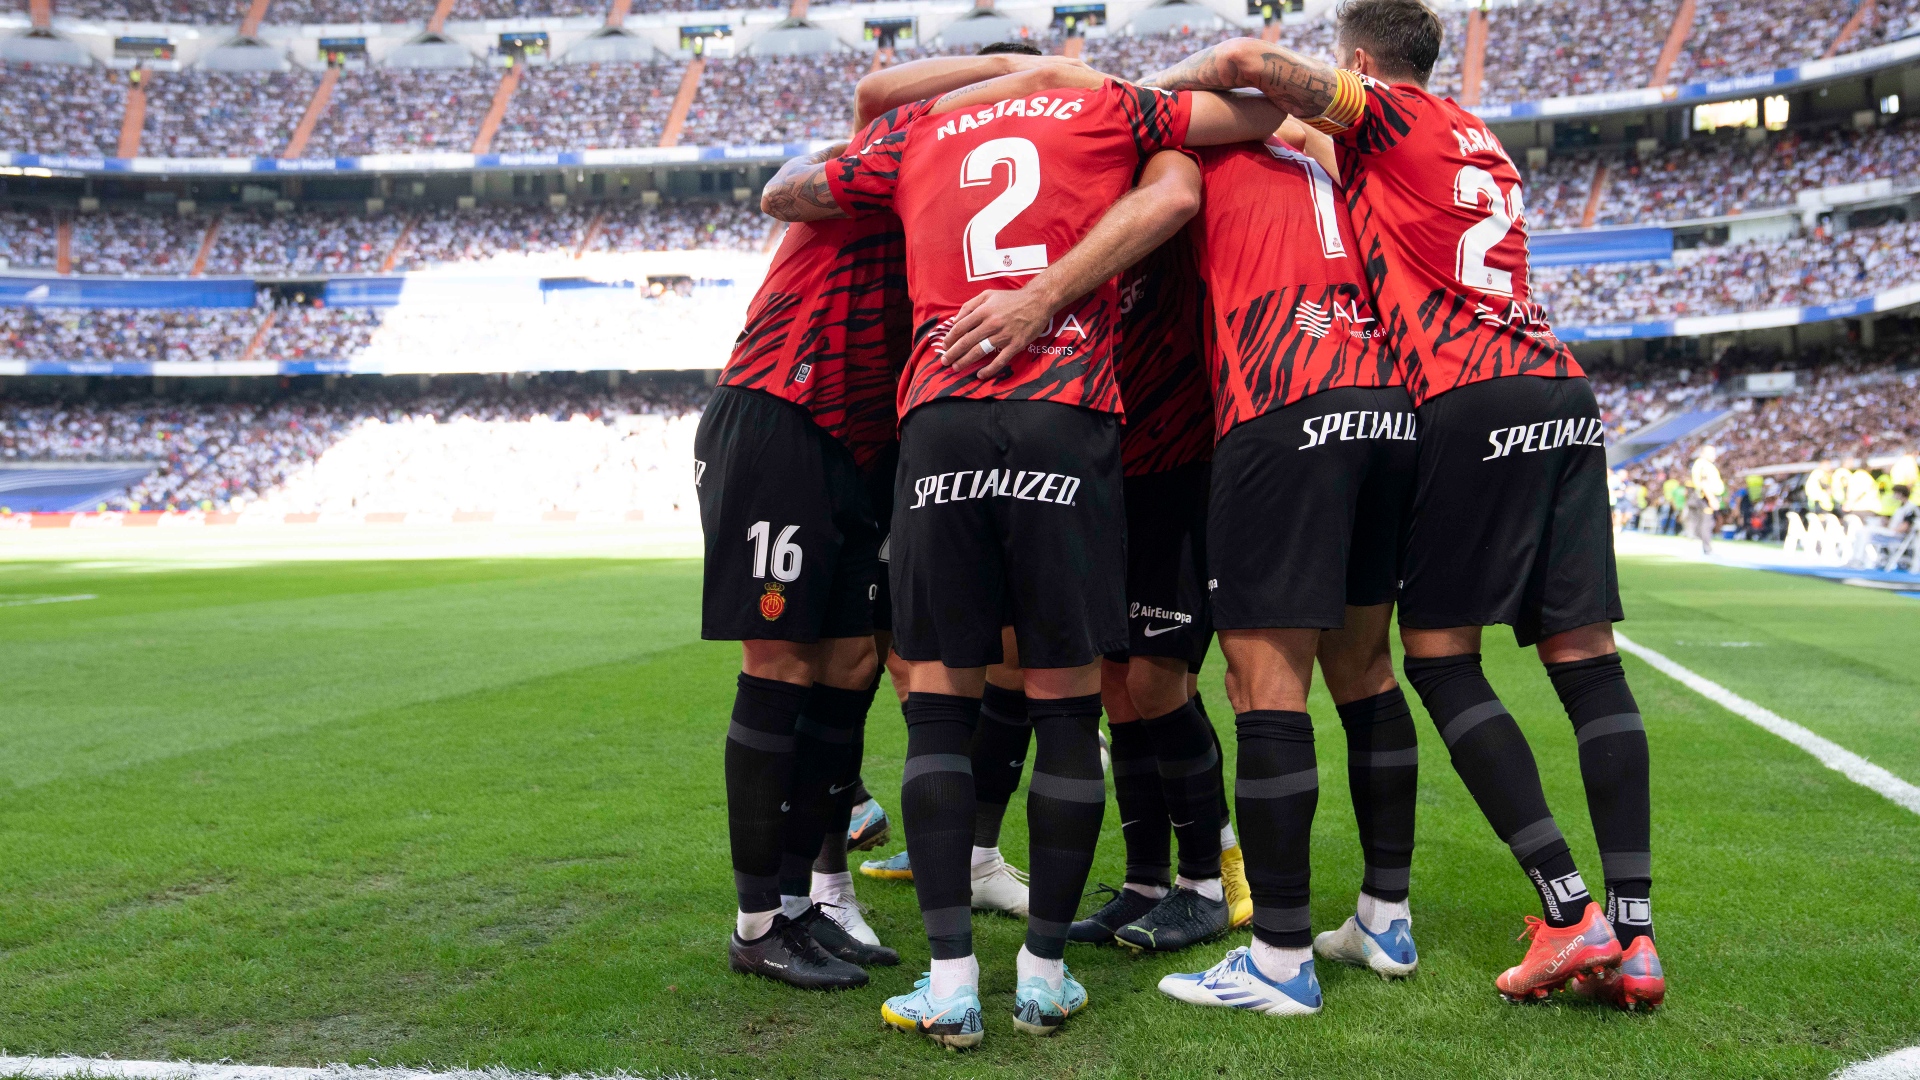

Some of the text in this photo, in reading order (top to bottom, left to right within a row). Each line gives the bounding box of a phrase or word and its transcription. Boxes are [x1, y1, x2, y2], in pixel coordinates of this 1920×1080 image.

[937, 96, 1085, 141] NASTASIĆ
[959, 136, 1049, 282] 2
[1483, 416, 1605, 461] SPECIALIZ
[747, 520, 803, 582] 16
[1533, 867, 1564, 922] TAPEDESIGN
[1545, 934, 1585, 974] ULTRA
